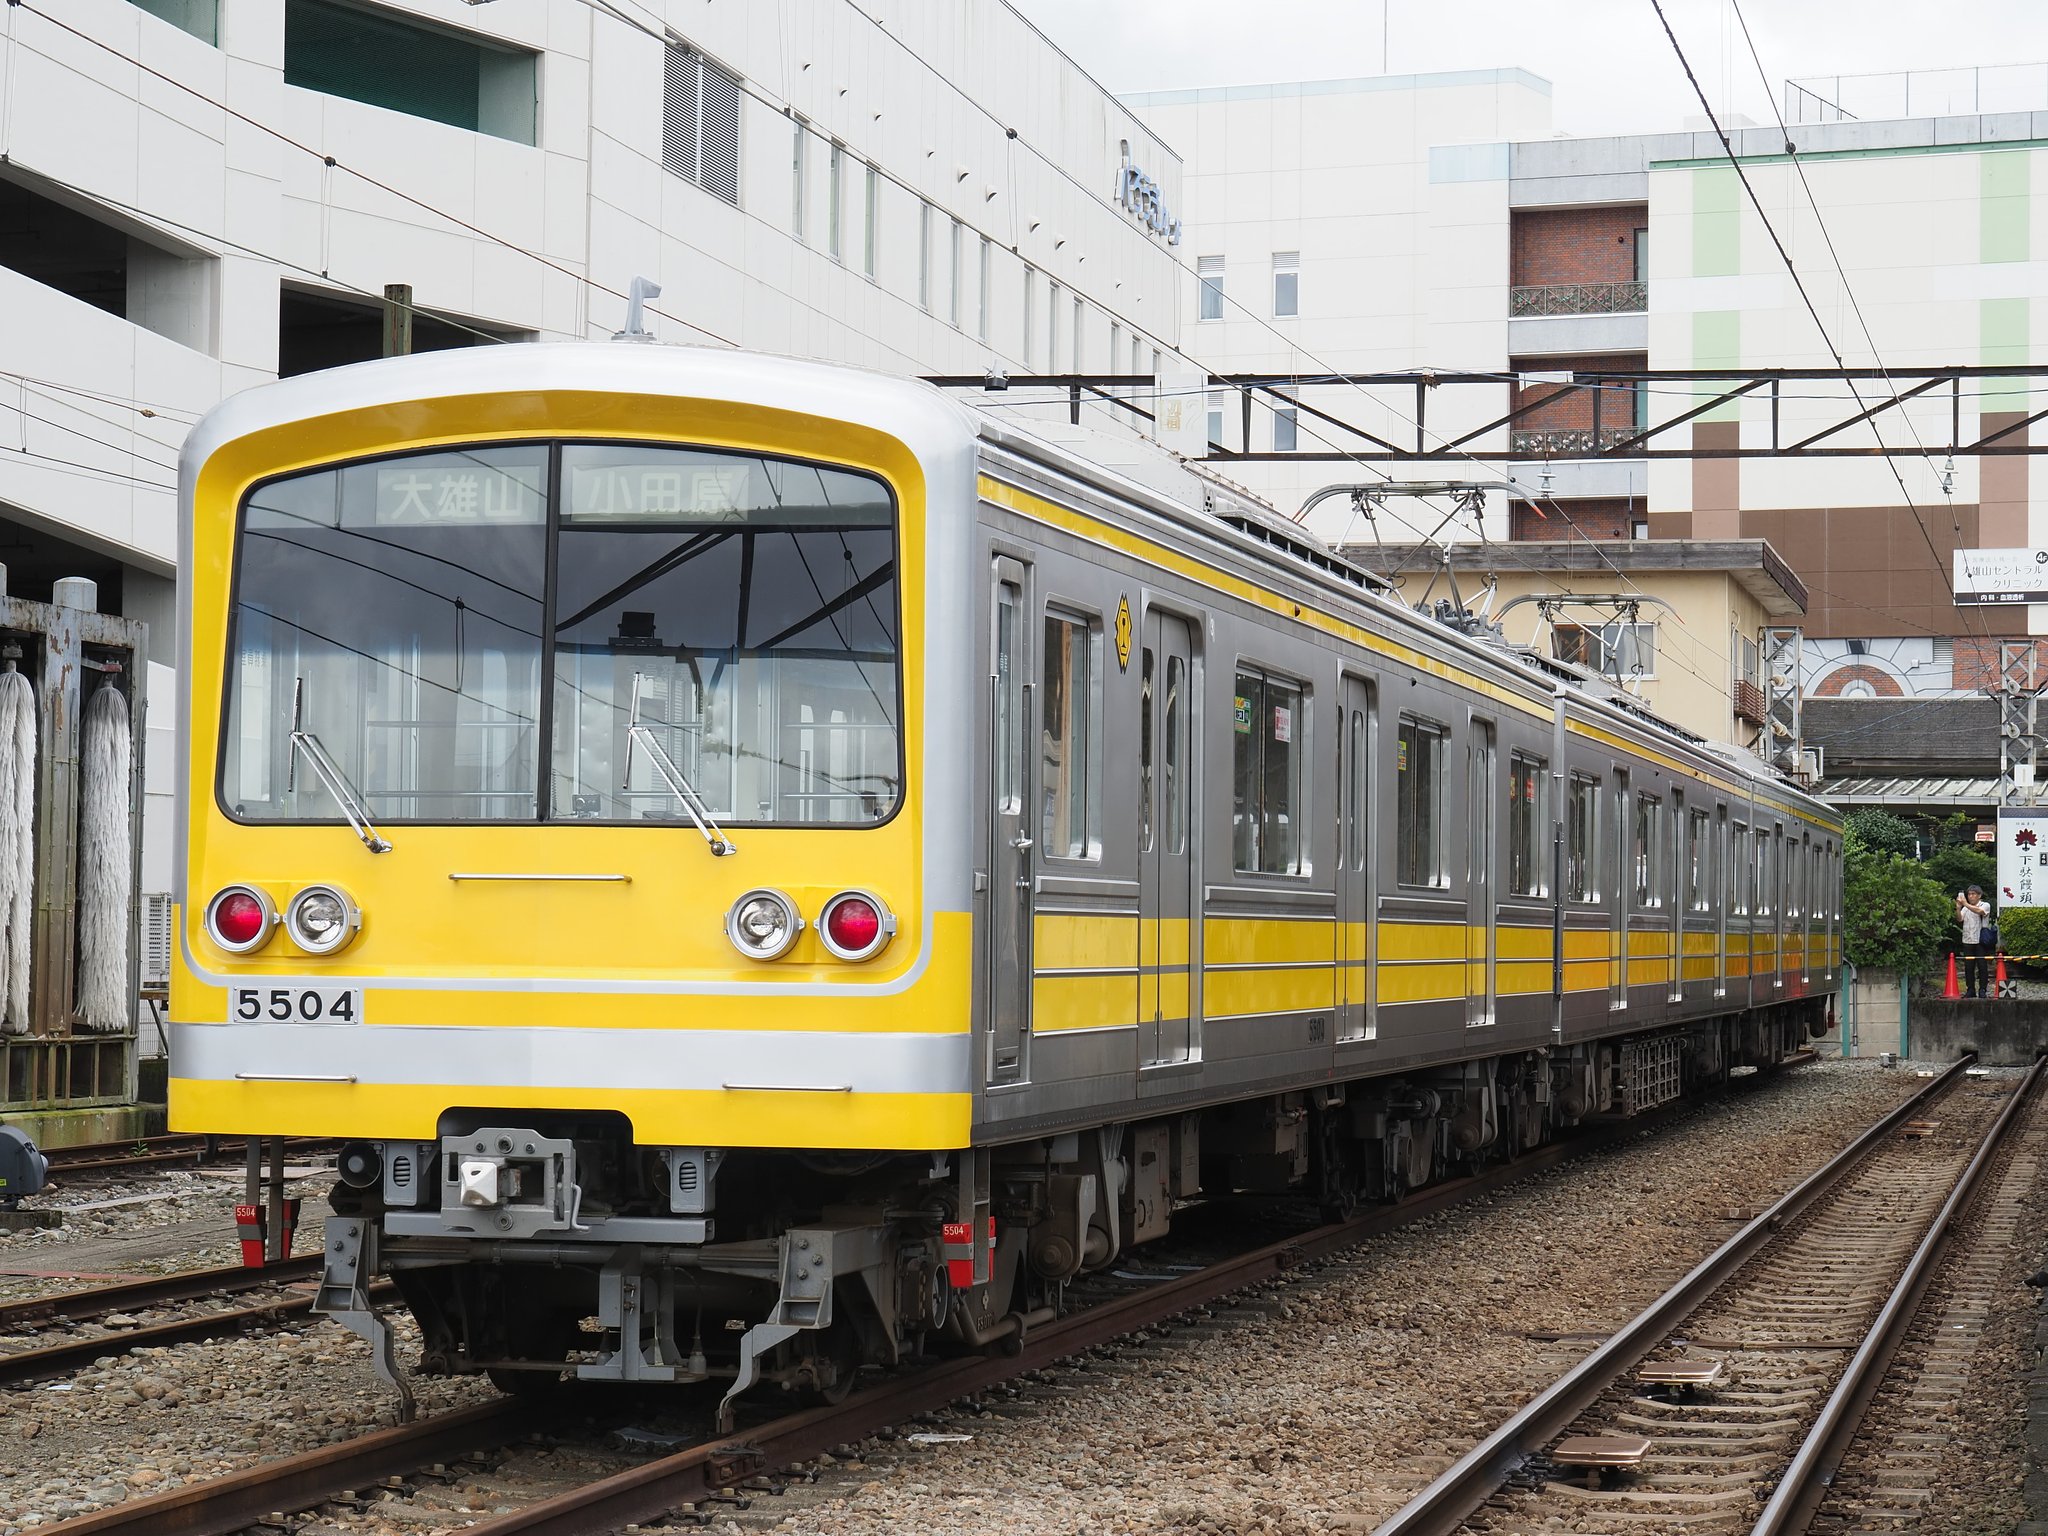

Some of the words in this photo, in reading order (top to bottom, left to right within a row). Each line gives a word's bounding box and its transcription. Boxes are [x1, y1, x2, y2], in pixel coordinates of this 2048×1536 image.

[391, 474, 523, 517] 大雄山
[590, 471, 732, 516] 小田原
[2036, 552, 2048, 563] 4F
[1993, 579, 2042, 590] クリニック
[238, 990, 353, 1021] 5504
[236, 1207, 256, 1217] 5504
[944, 1225, 964, 1236] 5504
